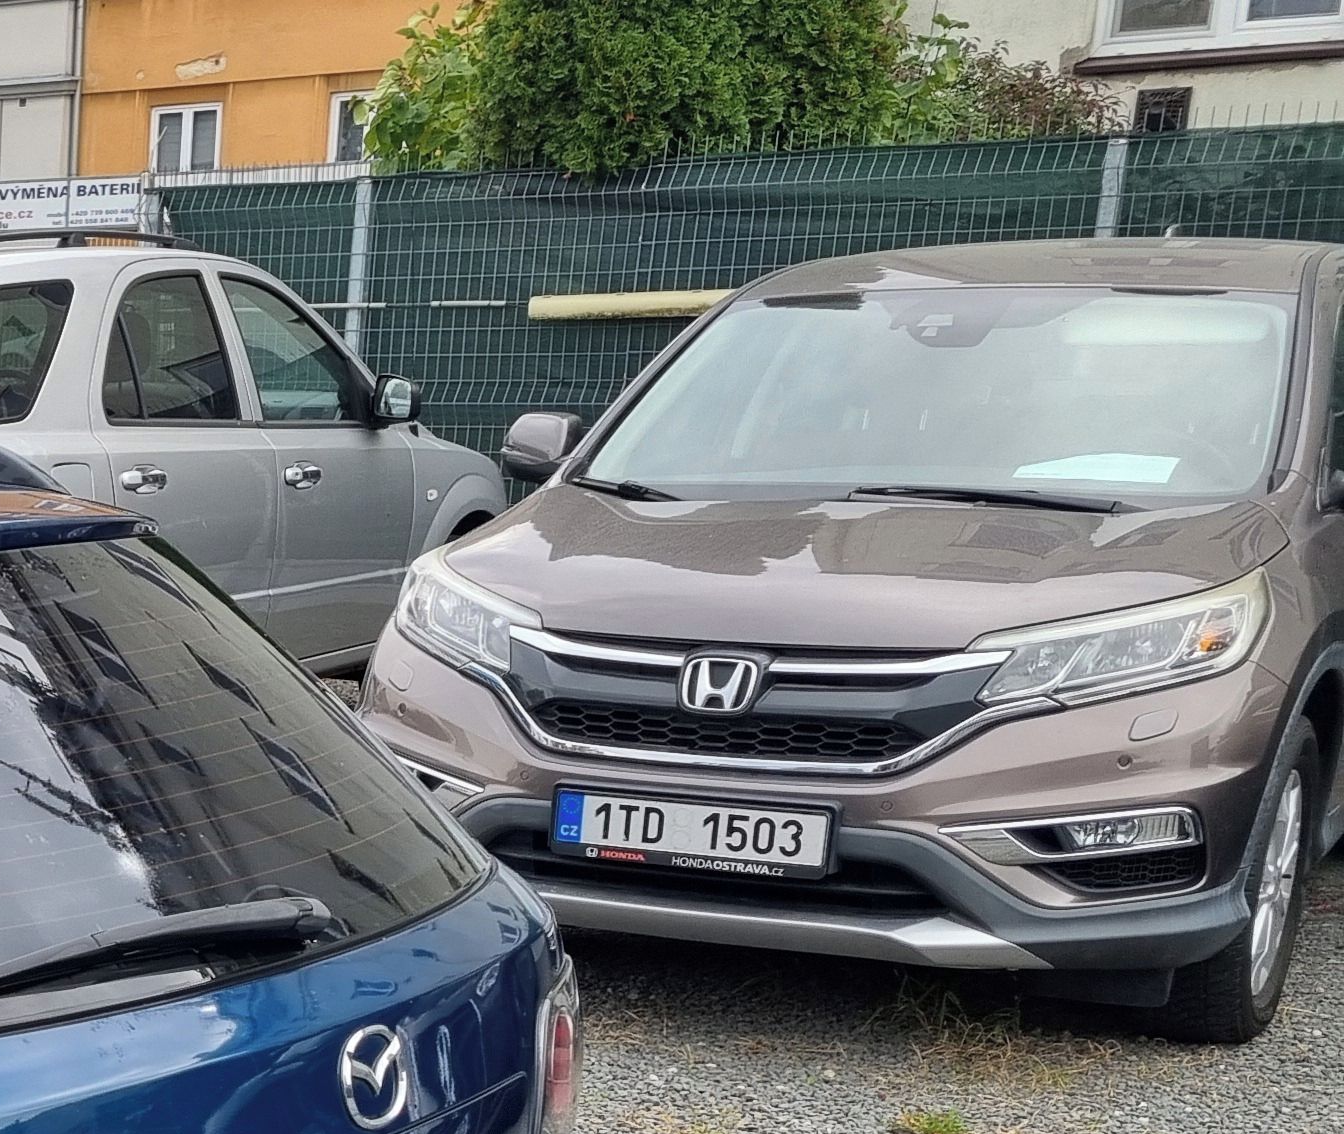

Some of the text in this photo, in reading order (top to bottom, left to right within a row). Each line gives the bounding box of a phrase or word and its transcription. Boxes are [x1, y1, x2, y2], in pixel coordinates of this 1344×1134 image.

[560, 824, 579, 837] CZ
[595, 802, 804, 858] 1TD 1503
[600, 850, 646, 862] HONDA
